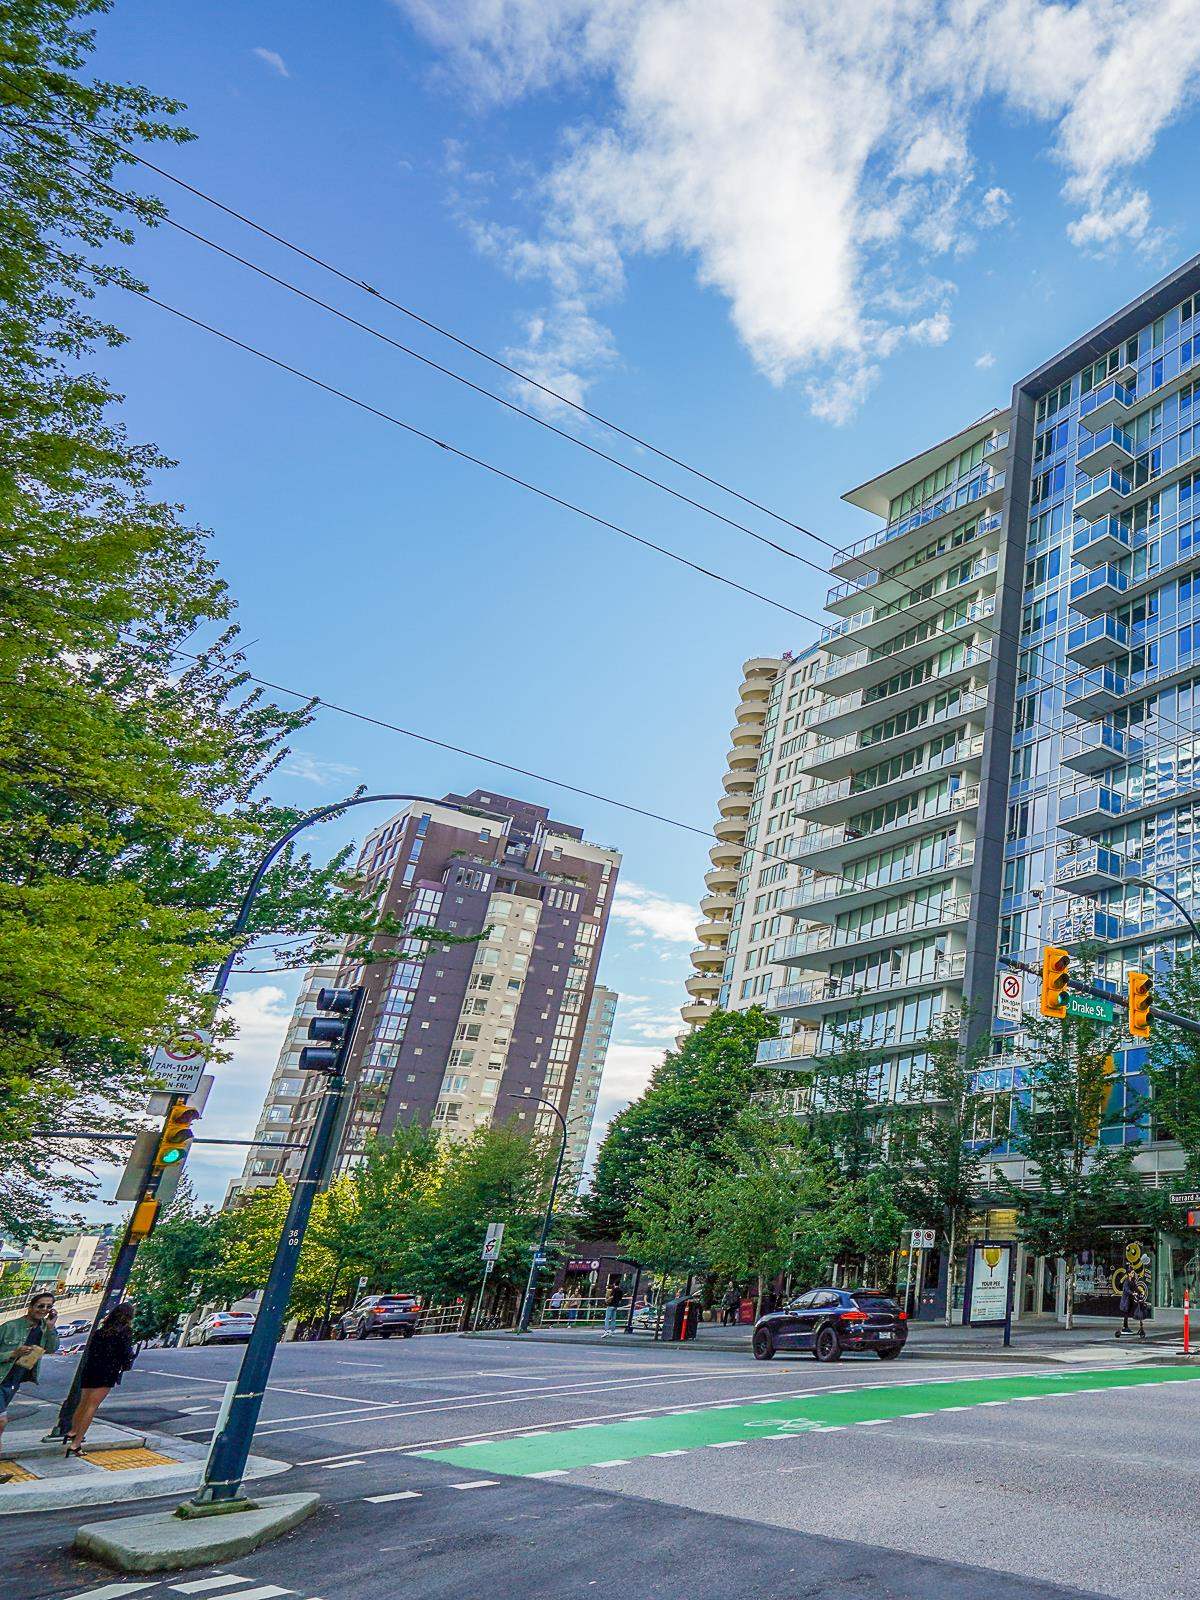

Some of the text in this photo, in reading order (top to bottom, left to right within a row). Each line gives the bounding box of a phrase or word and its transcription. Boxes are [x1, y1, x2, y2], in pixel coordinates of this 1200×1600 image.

[1072, 1000, 1106, 1018] Drake St.
[155, 1062, 200, 1073] 7AM-10AM
[154, 1071, 193, 1081] 3PM-7PM
[1171, 1193, 1194, 1203] Burrard
[288, 1238, 299, 1246] 09
